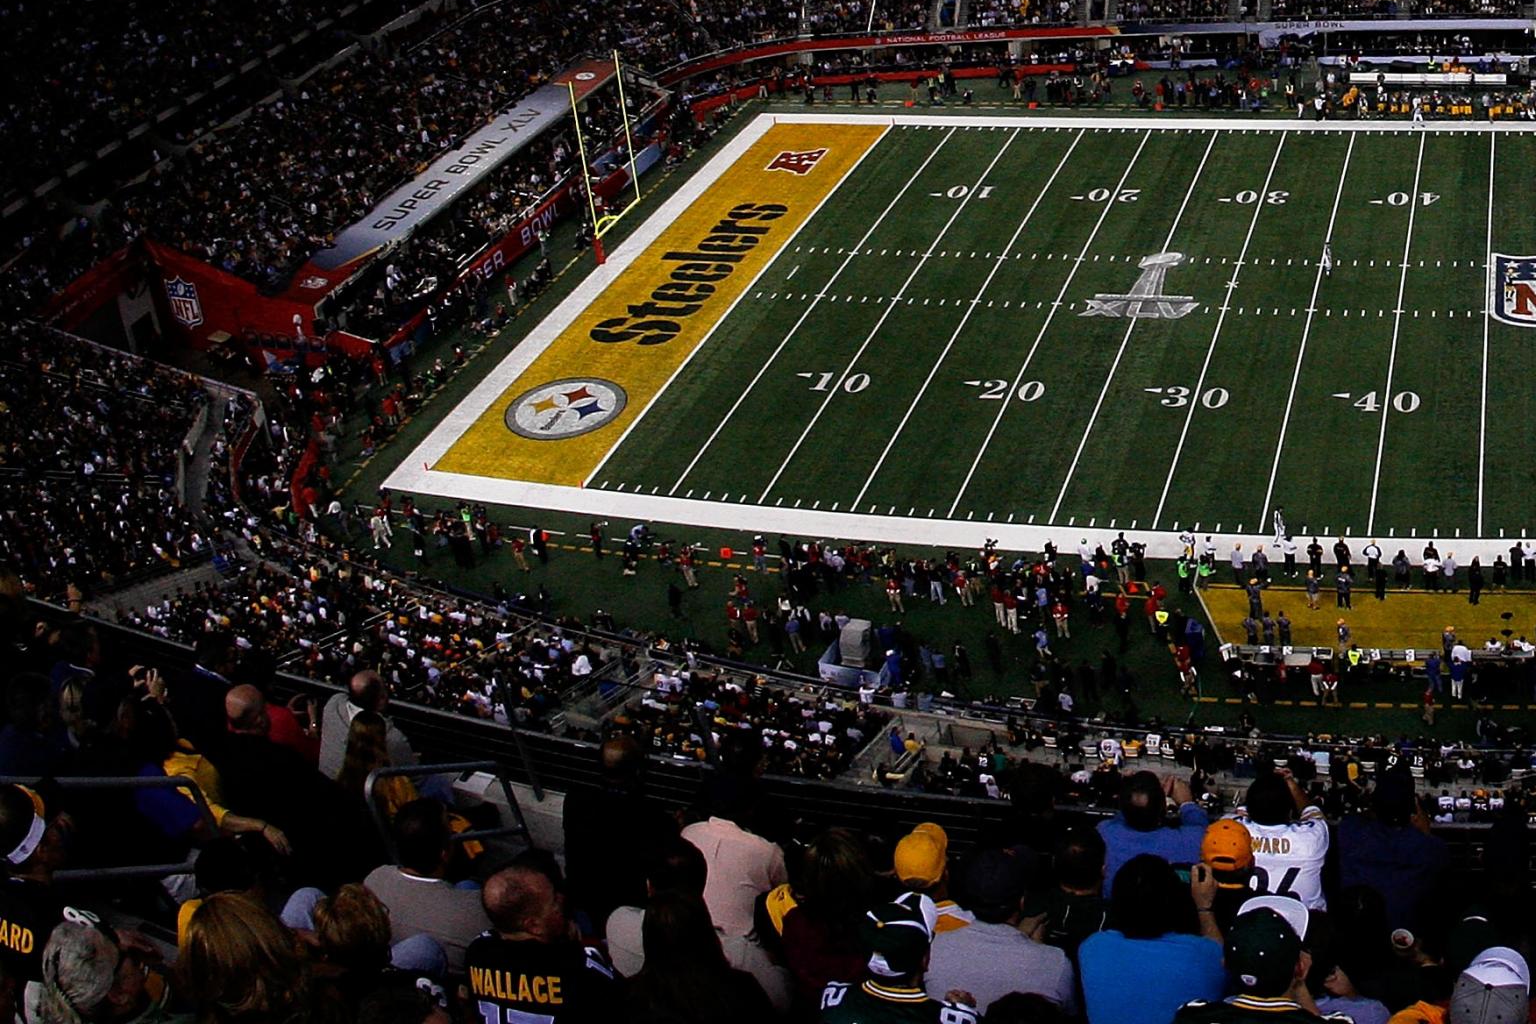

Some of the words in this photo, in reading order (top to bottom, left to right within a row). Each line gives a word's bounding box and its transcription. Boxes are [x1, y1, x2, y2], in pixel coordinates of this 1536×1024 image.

[886, 35, 926, 45] NATIONAL
[929, 33, 971, 43] FOOTBALL
[974, 31, 1007, 41] LEAGUE
[1315, 20, 1345, 29] BOWL
[373, 178, 450, 231] SUPER
[444, 137, 509, 175] BOWL
[500, 108, 542, 133] XLV
[947, 184, 997, 200] 10
[1087, 186, 1142, 203] 20
[1234, 189, 1291, 206] 30
[1386, 191, 1441, 208] 40
[589, 202, 789, 346] Steelers
[170, 296, 201, 323] NFL
[1079, 299, 1201, 319] XLV
[808, 372, 872, 394] 10
[978, 379, 1046, 403] 20
[1159, 384, 1230, 409] 30
[1352, 390, 1422, 414] 40
[1251, 836, 1291, 855] WARD
[0, 919, 34, 954] ARD
[469, 965, 564, 1005] WALLACE
